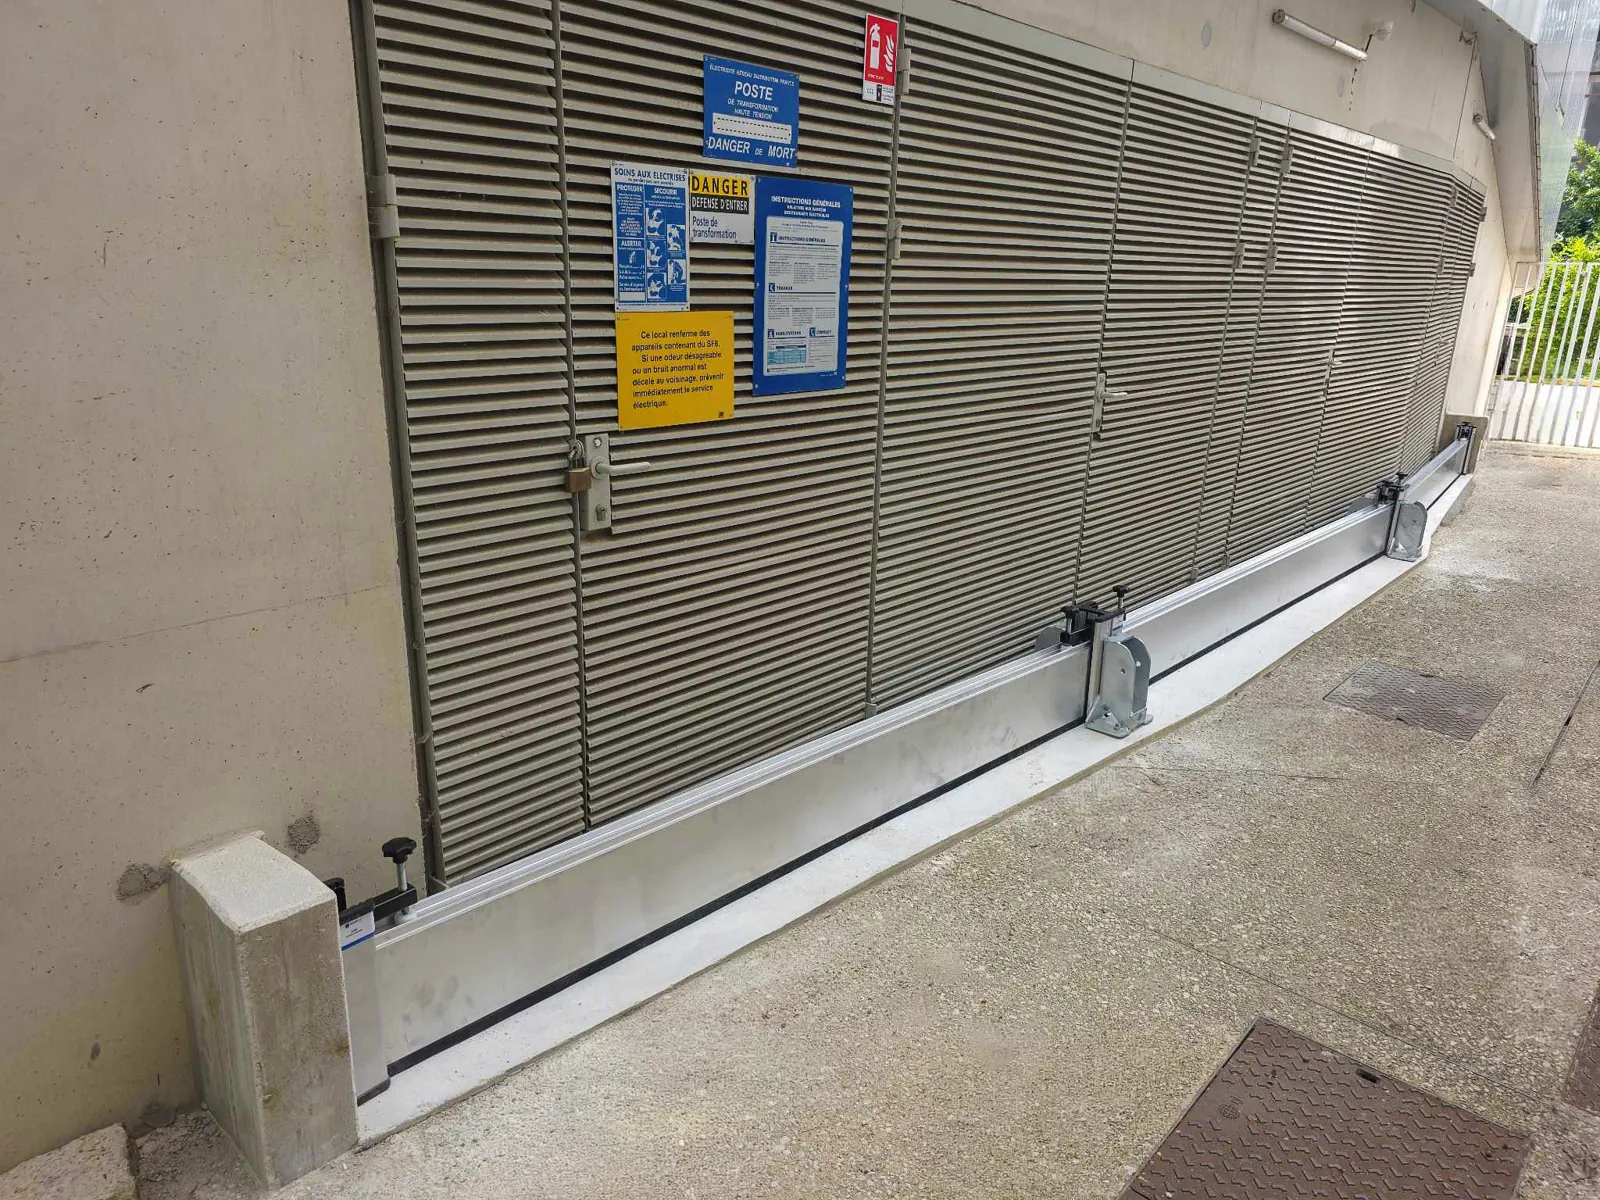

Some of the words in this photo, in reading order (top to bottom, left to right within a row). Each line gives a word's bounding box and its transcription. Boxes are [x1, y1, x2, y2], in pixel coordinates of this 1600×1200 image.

[734, 80, 773, 100] POSTE
[737, 100, 779, 113] TRANSFORMATION
[734, 108, 750, 116] HAUTE
[752, 111, 772, 120] TENSION
[708, 136, 750, 154] DANGER
[755, 148, 763, 156] DE
[768, 145, 796, 160] MORT
[614, 168, 635, 177] SOINS
[637, 170, 651, 178] AUX
[654, 171, 686, 182] ELECTRISES
[692, 176, 748, 196] DANGER
[692, 197, 718, 209] DEFENSE
[720, 199, 748, 211] D'ENTRER
[771, 196, 811, 205] INSTRUCTIONS
[693, 216, 709, 226] Poste
[711, 216, 718, 227] de
[693, 228, 737, 239] transformation
[641, 331, 650, 339] Ce
[670, 329, 697, 338] renferme
[699, 329, 710, 337] des
[632, 343, 662, 352] appareils
[665, 341, 696, 349] contenant
[642, 354, 649, 362] Si
[685, 352, 721, 361] désagréable
[670, 364, 696, 372] anormal
[700, 372, 724, 382] prévenir
[633, 387, 683, 397] immédiatement
[633, 400, 668, 409] électrique.
